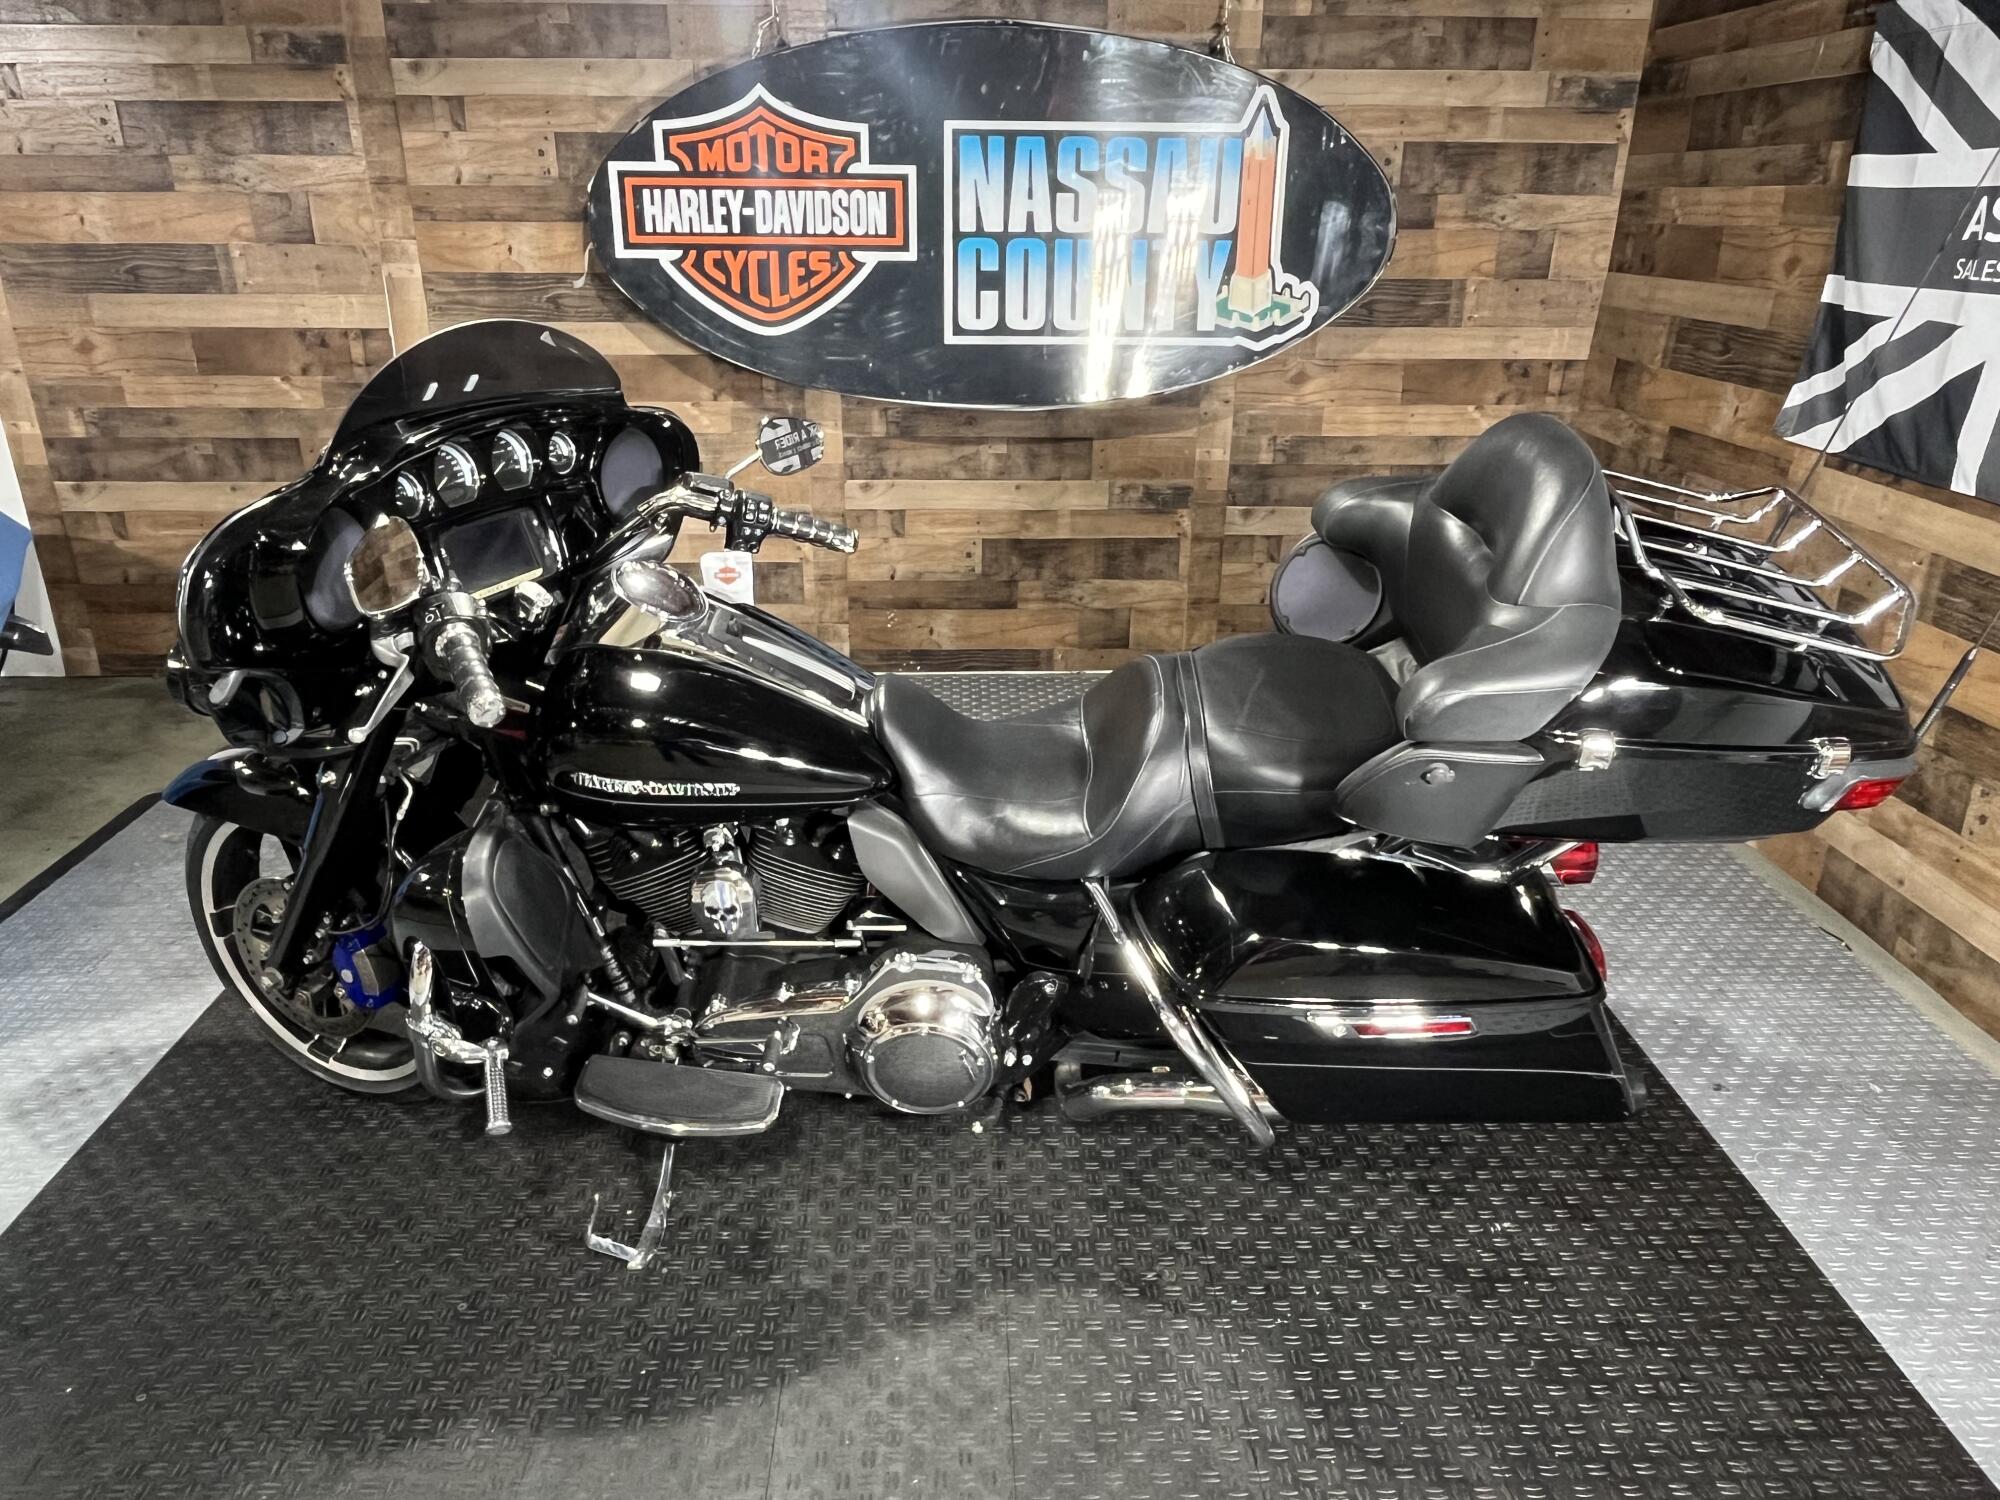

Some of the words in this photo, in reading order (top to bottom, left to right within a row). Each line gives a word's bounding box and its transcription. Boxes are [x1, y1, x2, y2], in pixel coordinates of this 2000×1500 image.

[698, 121, 828, 173] MOTOR
[642, 189, 887, 235] HARLEY-DAVIDSON
[959, 135, 1242, 234] NASSAU
[703, 250, 831, 308] CYCLES
